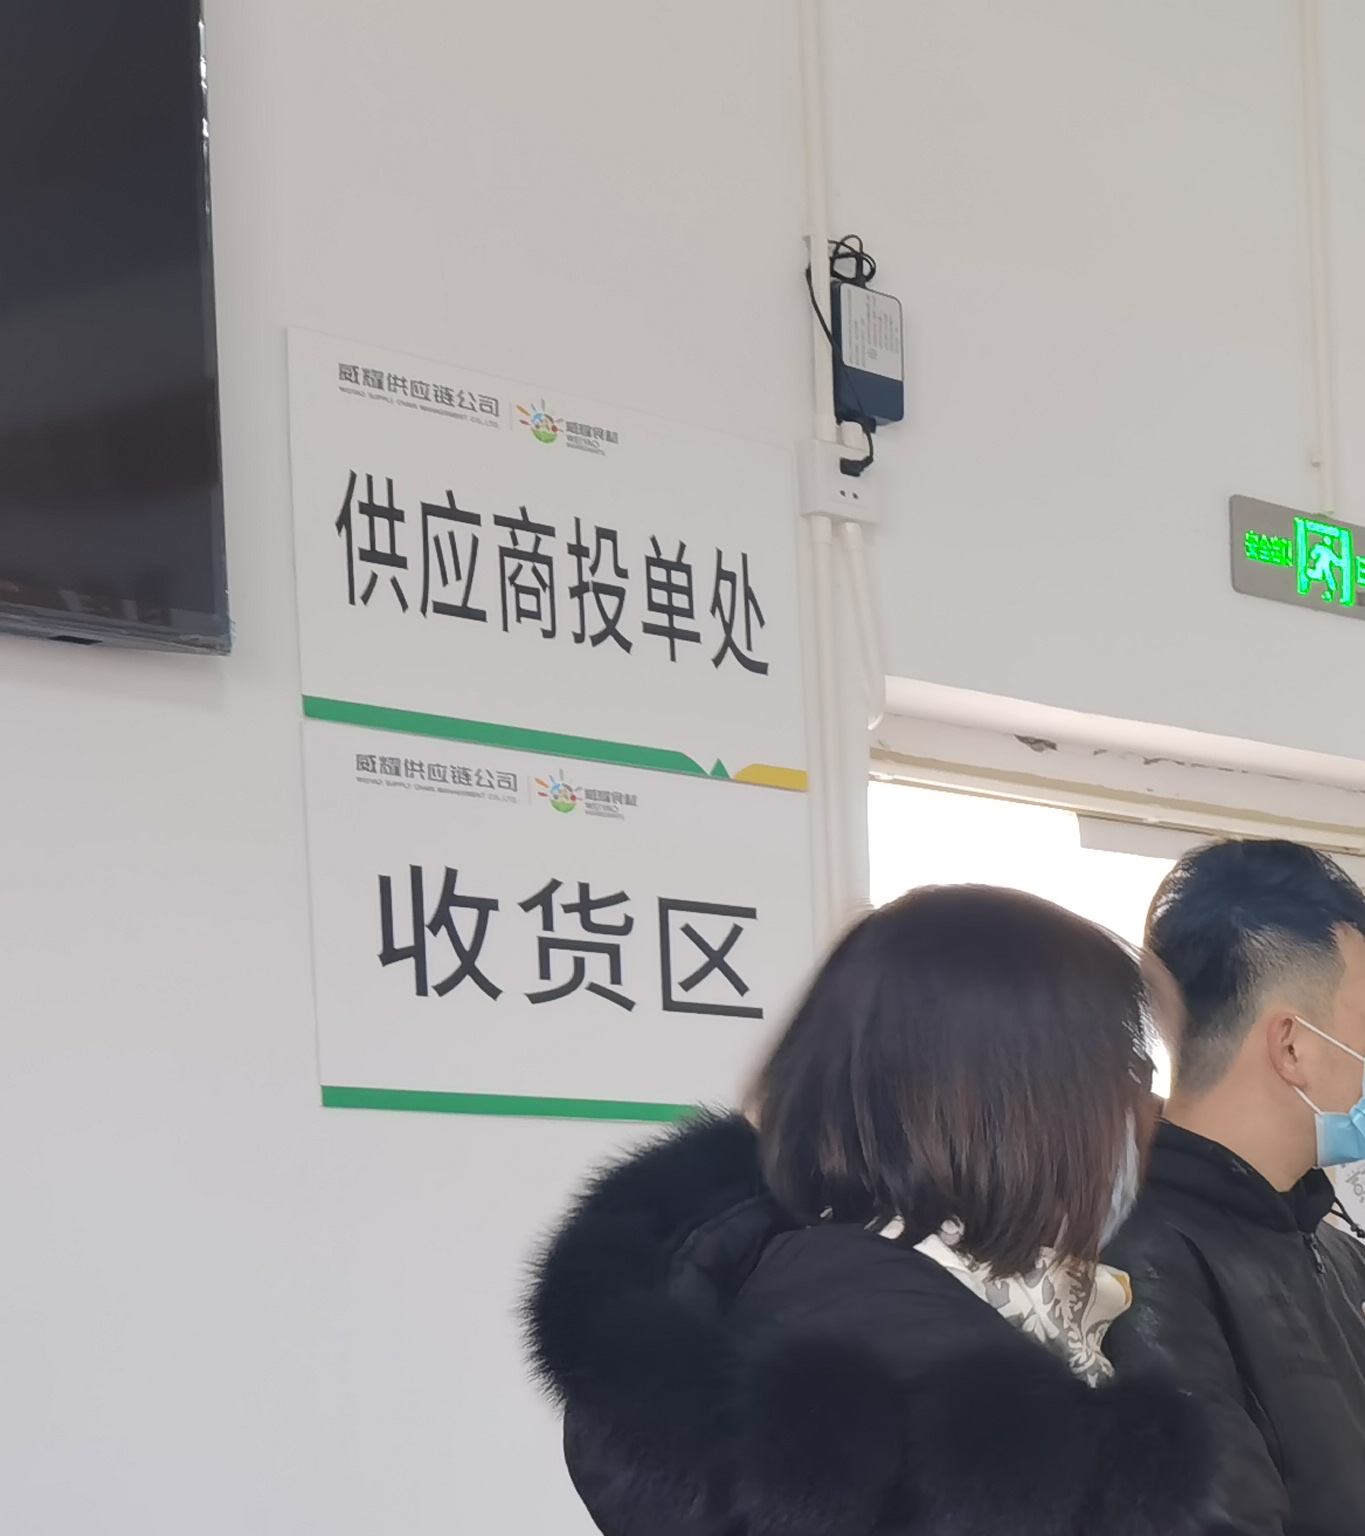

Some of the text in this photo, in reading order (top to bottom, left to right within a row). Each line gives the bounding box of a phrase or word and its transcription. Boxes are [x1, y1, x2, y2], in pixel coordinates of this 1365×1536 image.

[338, 362, 500, 418] 威耀供应链公司
[334, 469, 770, 677] 供应商投单处
[354, 753, 519, 793] 威耀供应链公司
[376, 862, 765, 1021] 收货区
